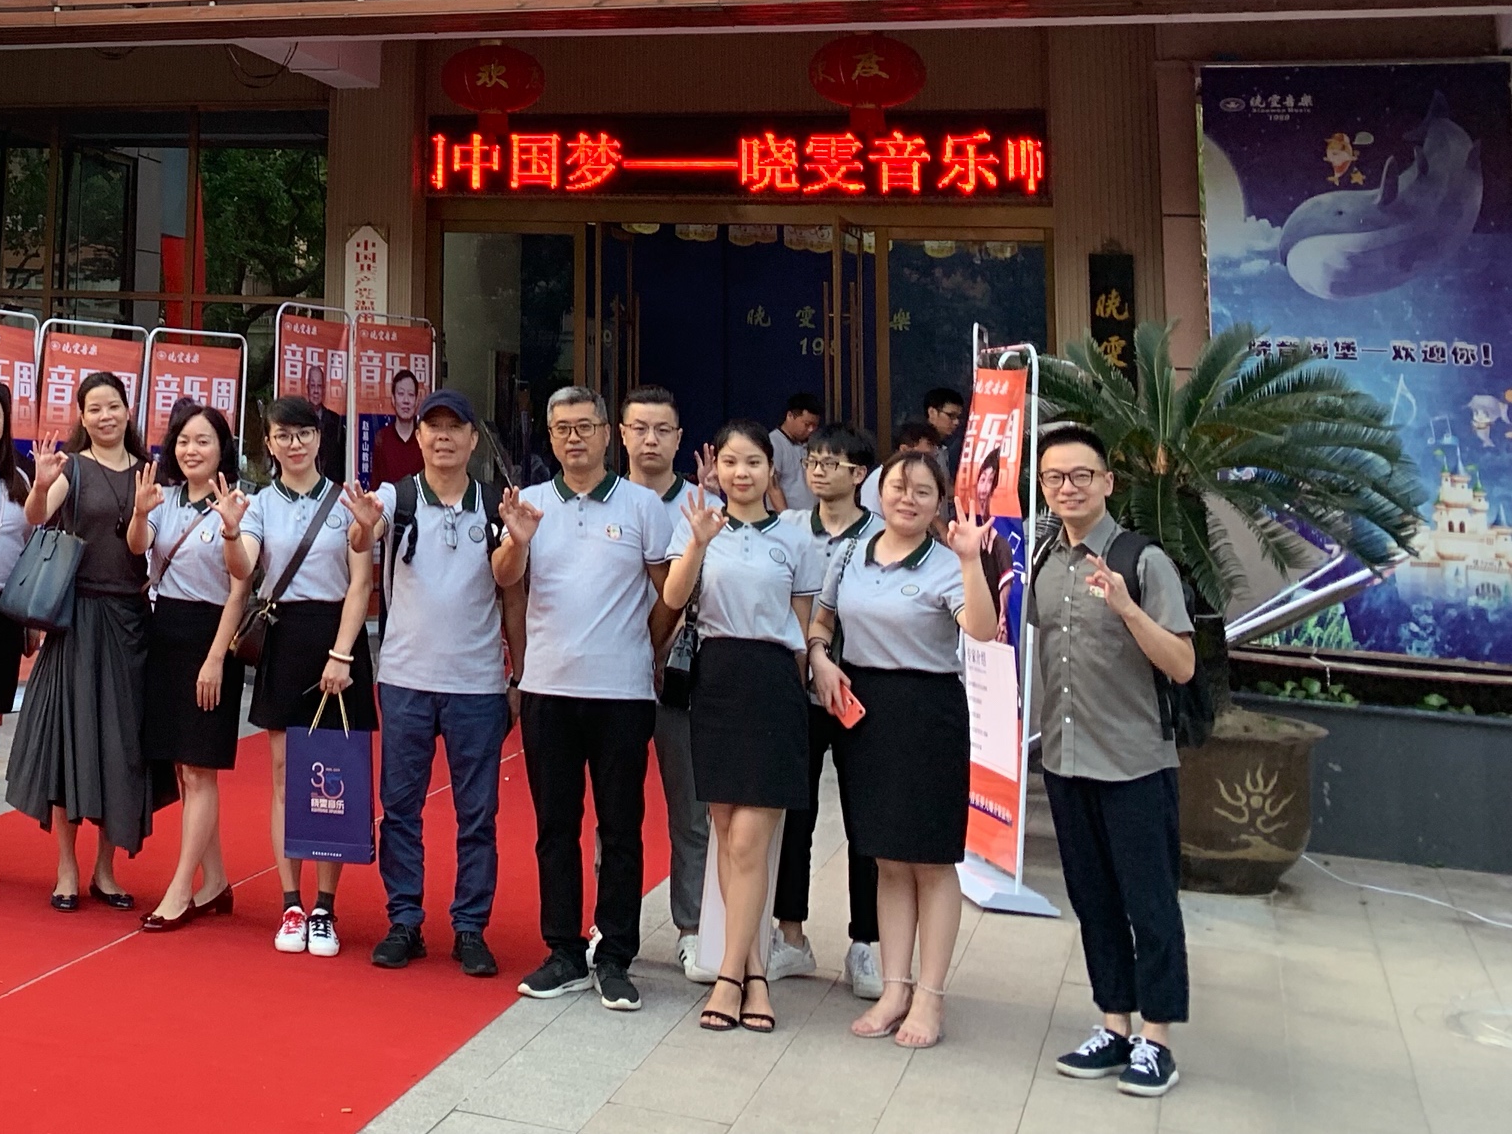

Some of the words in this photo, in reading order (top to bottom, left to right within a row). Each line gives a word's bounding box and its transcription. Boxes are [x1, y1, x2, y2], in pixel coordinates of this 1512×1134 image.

[431, 130, 1042, 194] 中国梦——晓雯音乐
